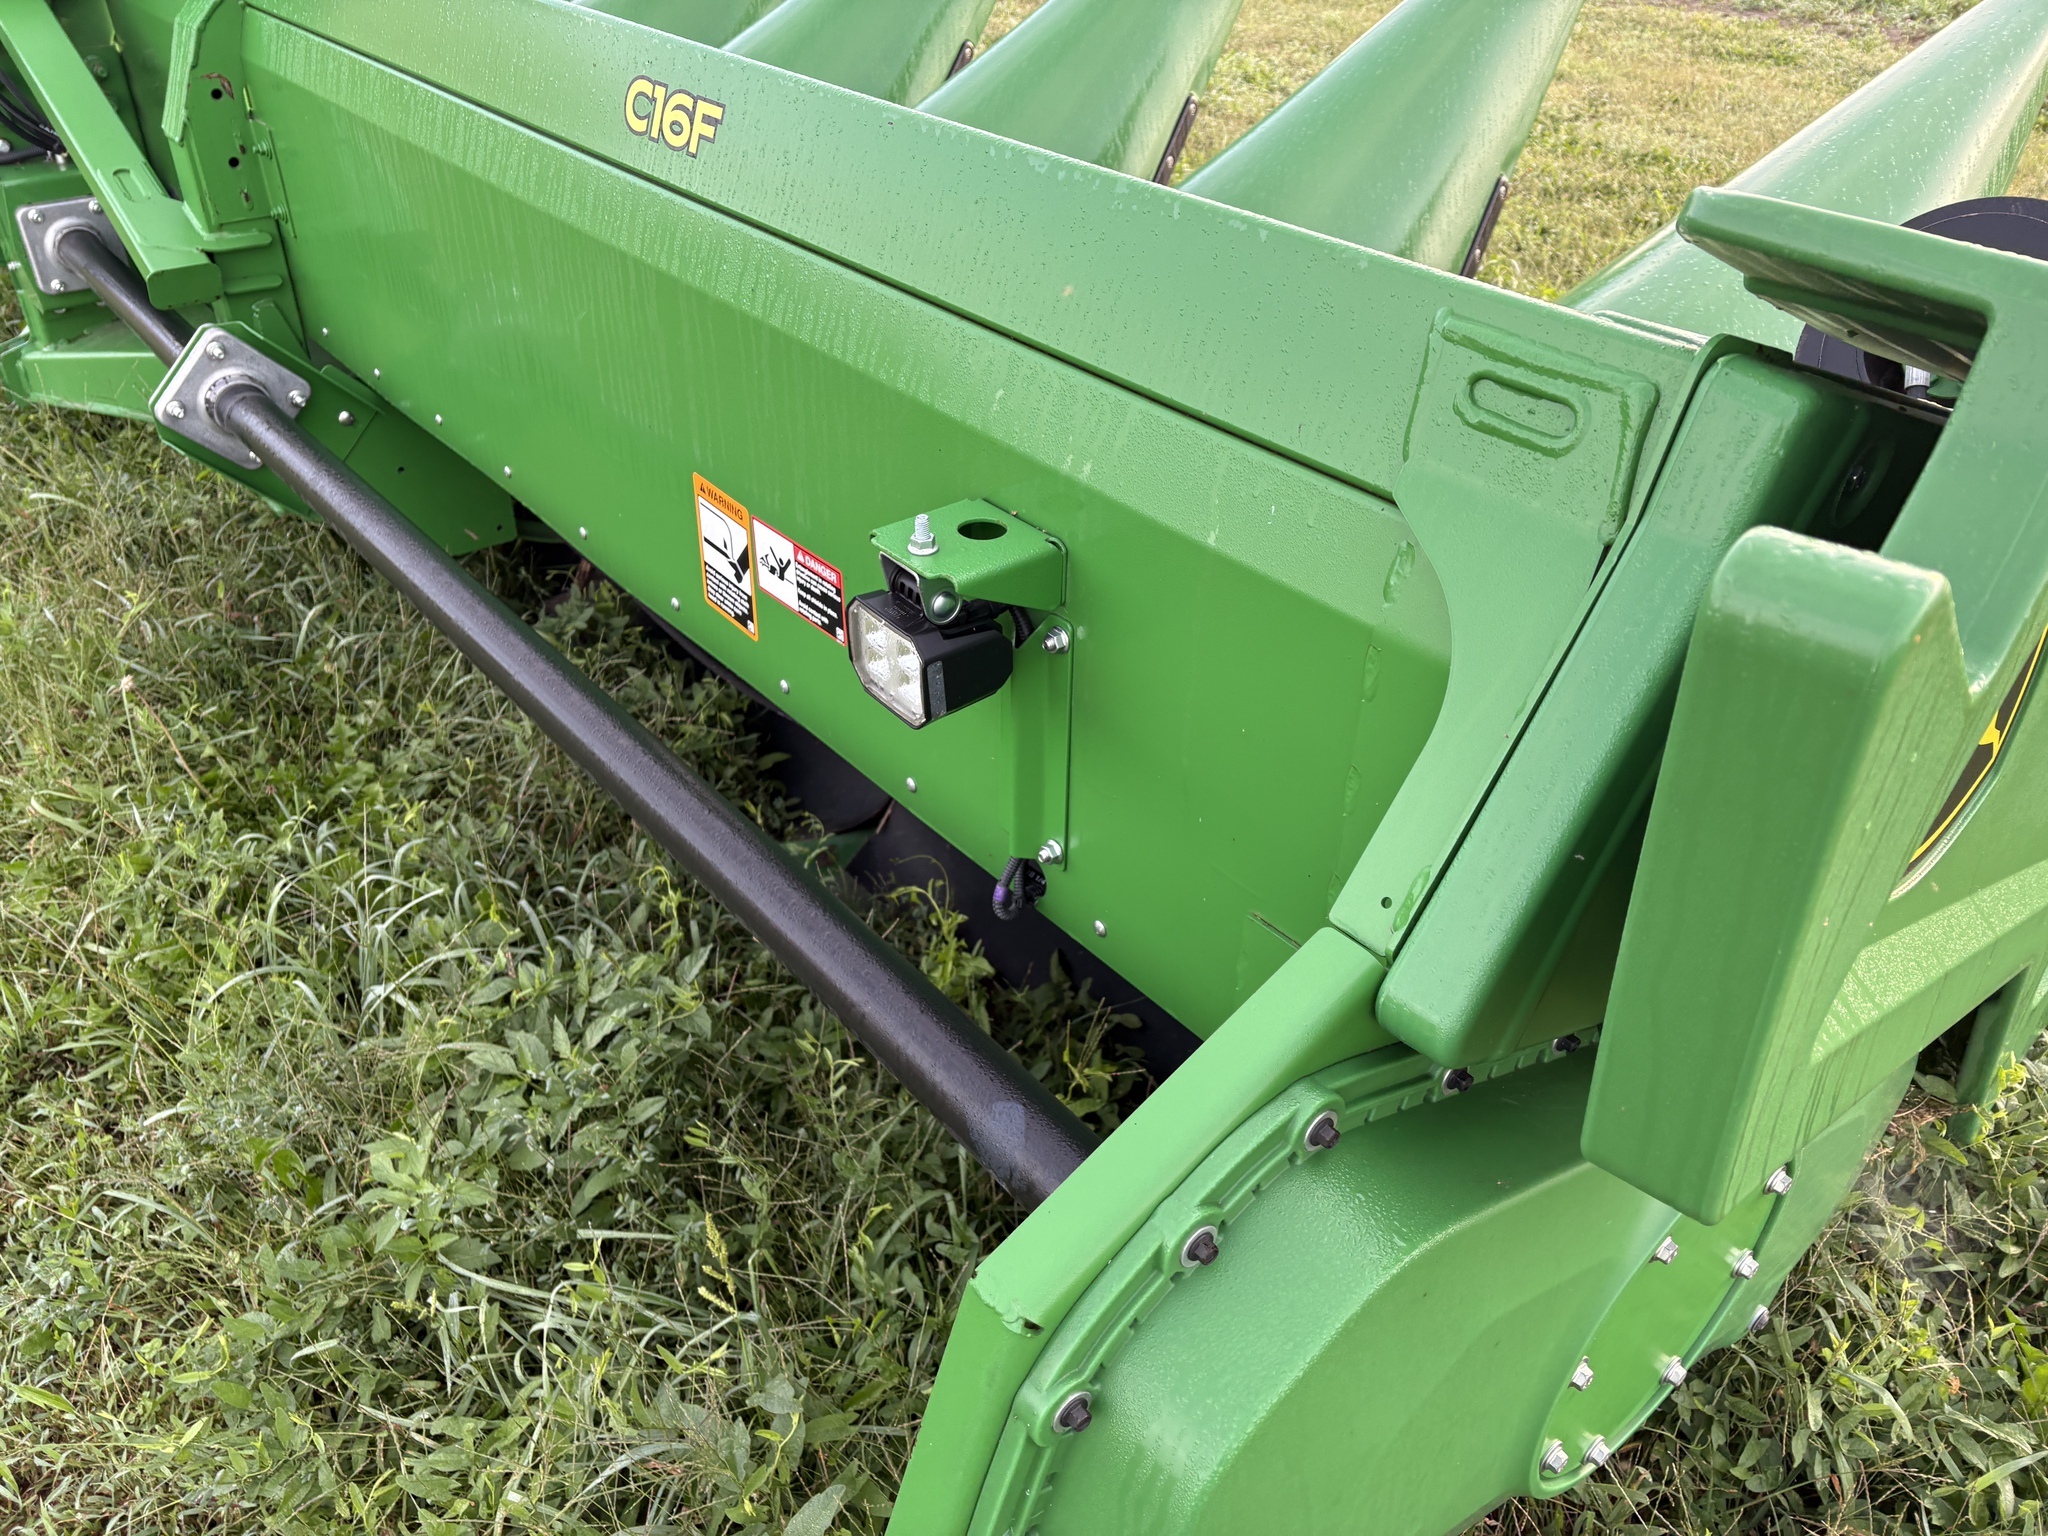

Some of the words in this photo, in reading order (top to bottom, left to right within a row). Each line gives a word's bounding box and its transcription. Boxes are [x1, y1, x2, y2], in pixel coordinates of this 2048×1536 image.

[624, 75, 726, 159] C16F
[706, 485, 743, 520] WARNING
[805, 555, 837, 584] DANGER
